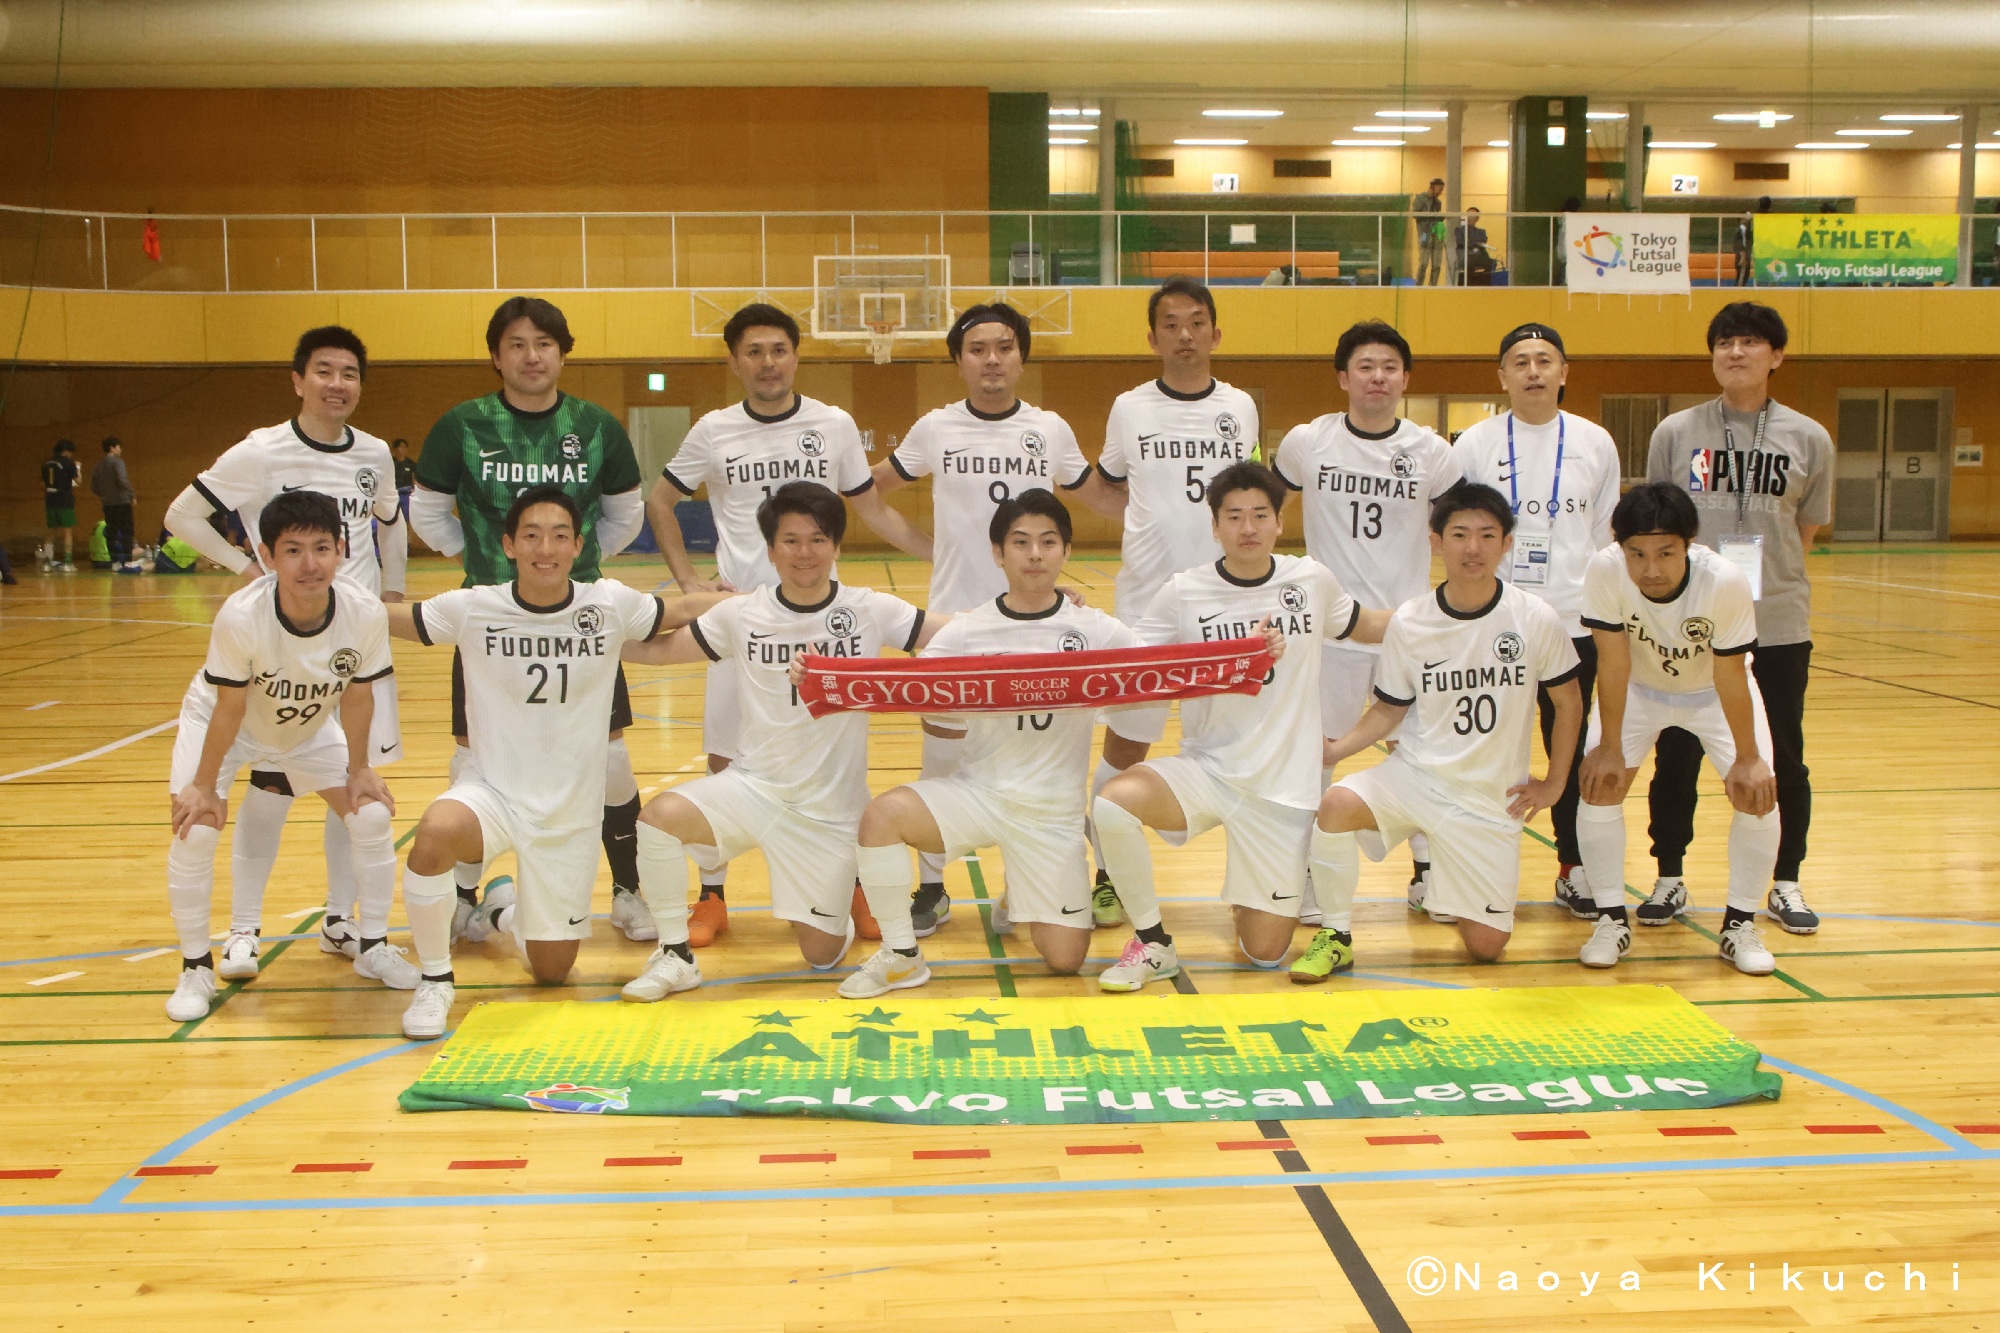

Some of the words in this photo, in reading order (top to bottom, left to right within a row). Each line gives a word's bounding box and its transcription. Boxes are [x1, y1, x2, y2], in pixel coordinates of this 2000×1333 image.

[1674, 178, 1684, 192] 2
[1631, 233, 1677, 249] Tokyo
[1797, 230, 1912, 249] ATHLETA
[1632, 247, 1676, 260] Futsal
[1629, 260, 1682, 276] League
[1795, 263, 1841, 280] Tokyo
[1844, 263, 1888, 277] Futsal
[1891, 263, 1944, 280] League
[1140, 441, 1244, 461] FUDOMAE
[482, 461, 588, 483] FUDOMAE
[726, 459, 829, 486] FUDOMAE
[943, 456, 1049, 477] FUDOMAE
[1711, 449, 1790, 497] PARIS
[1906, 456, 1921, 474] B
[1185, 465, 1206, 504] 5
[1318, 471, 1418, 500] FUDOMAE
[1515, 498, 1587, 515] OOSH
[1350, 501, 1383, 540] 13
[485, 635, 606, 658] FUDOMAE
[254, 675, 345, 701] FUDOMA
[526, 663, 568, 704] 21
[1010, 677, 1070, 691] SOCCER
[1080, 662, 1228, 700] GYOSEI
[1422, 665, 1526, 694] FUDOMAE
[847, 679, 997, 706] GYOSEI
[1013, 690, 1067, 702] TOKYO
[275, 703, 322, 726] 99
[1454, 694, 1497, 735] 30
[1042, 1080, 1334, 1111] Futsal
